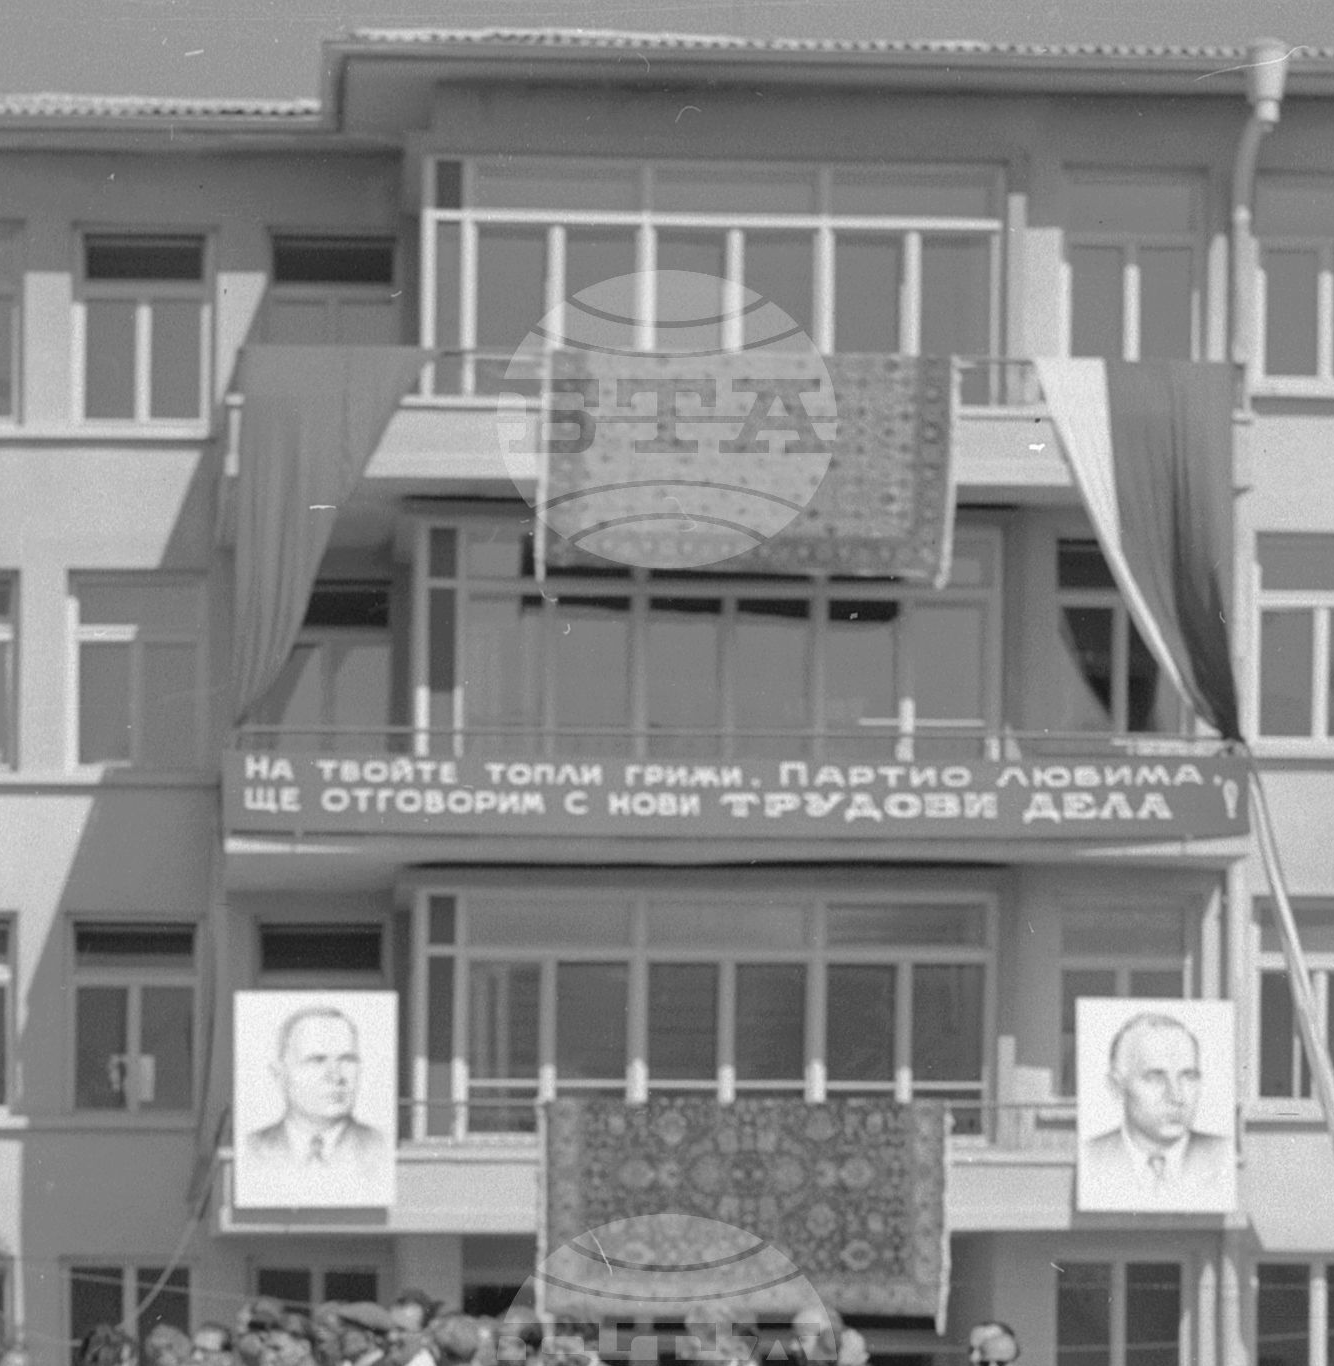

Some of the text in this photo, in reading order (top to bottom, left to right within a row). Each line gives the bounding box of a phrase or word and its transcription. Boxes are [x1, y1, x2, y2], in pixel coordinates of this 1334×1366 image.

[245, 755, 294, 781] НА
[316, 757, 458, 785] ТВОЙТЕ
[484, 762, 603, 786] ТОПЛИ
[244, 786, 301, 814] ЩЕ
[320, 786, 546, 815] ОТГОВОРИМ
[563, 790, 589, 816] С
[608, 791, 701, 817] НОВИ
[719, 791, 998, 823] ТРУДОВИ
[1021, 791, 1173, 825] ДЕЛА
